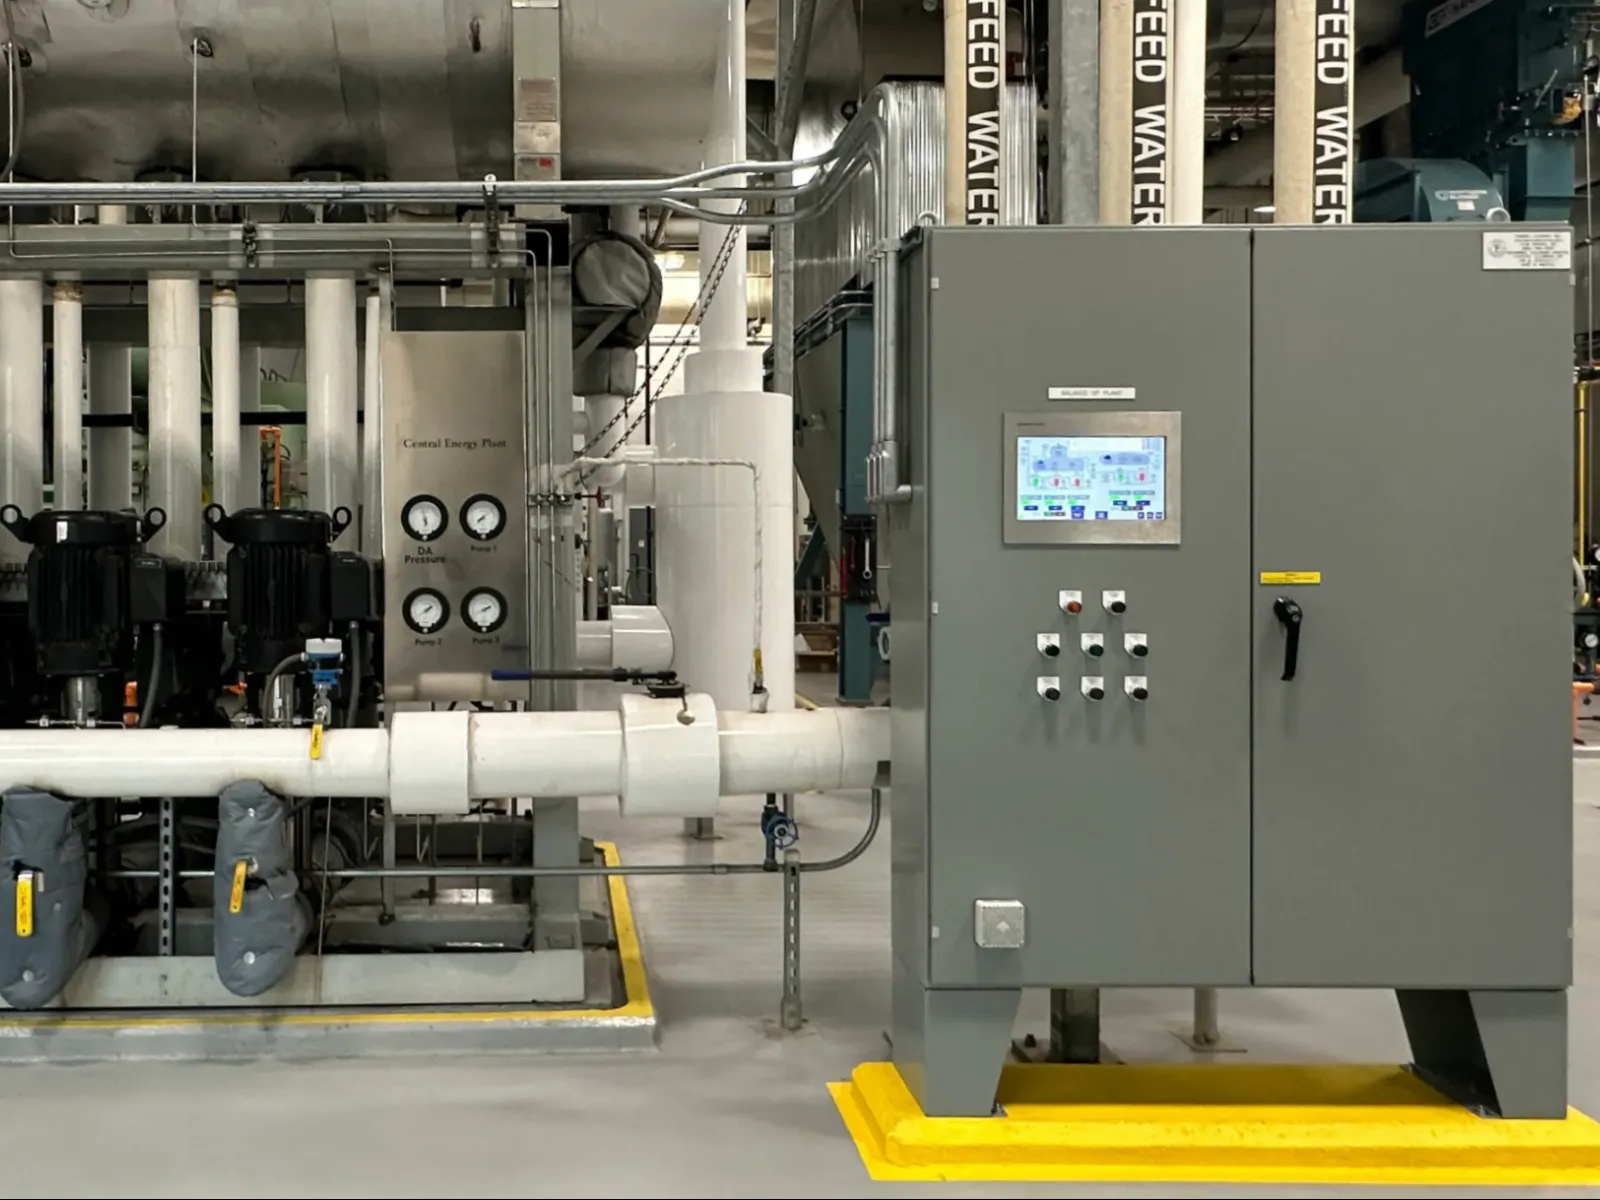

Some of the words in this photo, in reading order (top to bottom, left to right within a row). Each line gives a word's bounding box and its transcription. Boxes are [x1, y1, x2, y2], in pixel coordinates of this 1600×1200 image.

[1134, 104, 1166, 225] WATER
[403, 438, 441, 449] Central
[444, 438, 478, 450] Energy
[481, 438, 507, 449] Plant
[417, 546, 433, 555] DA
[470, 545, 491, 553] Pump
[404, 555, 446, 564] Pressure
[415, 638, 436, 646] Pump
[472, 637, 493, 645] Pump
